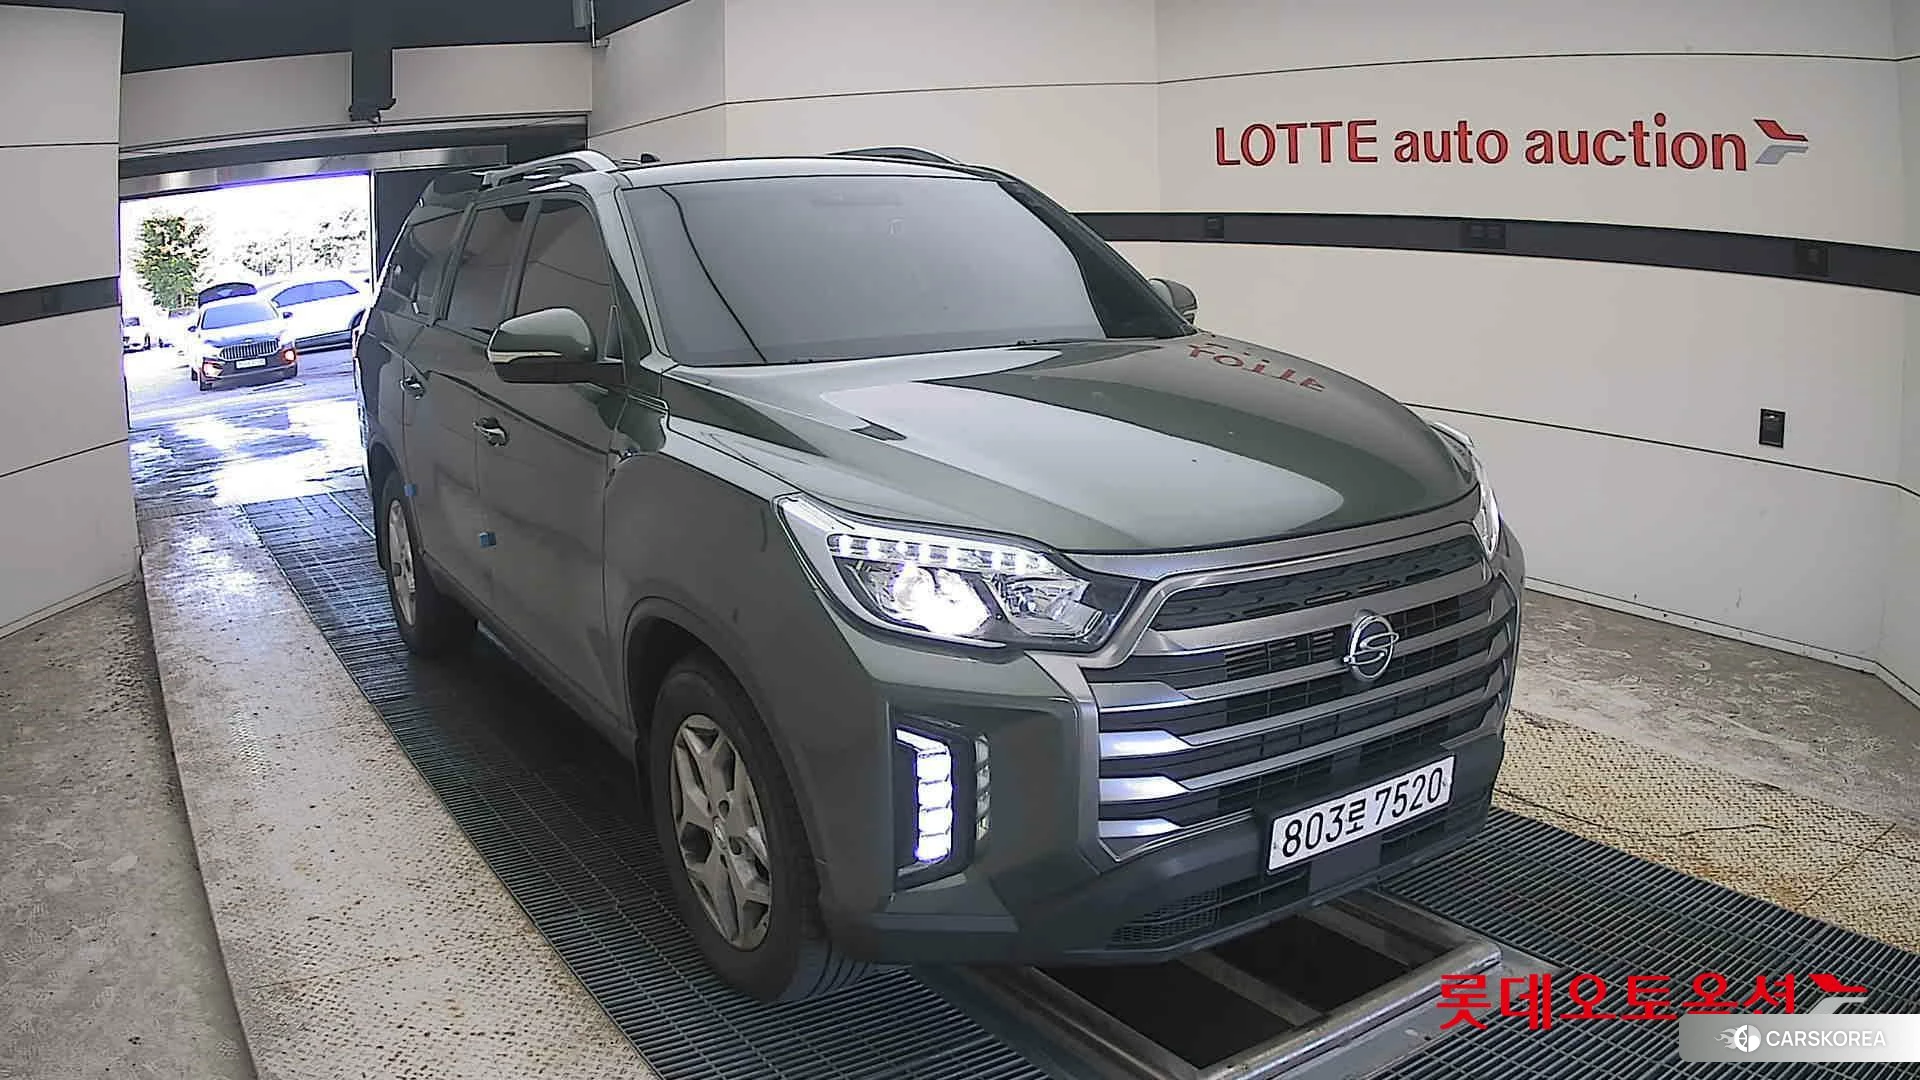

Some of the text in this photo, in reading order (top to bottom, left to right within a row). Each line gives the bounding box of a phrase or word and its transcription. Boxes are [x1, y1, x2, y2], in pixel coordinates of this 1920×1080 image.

[1215, 112, 1747, 171] LOTTE auto auction
[1281, 767, 1443, 858] 803로 7520
